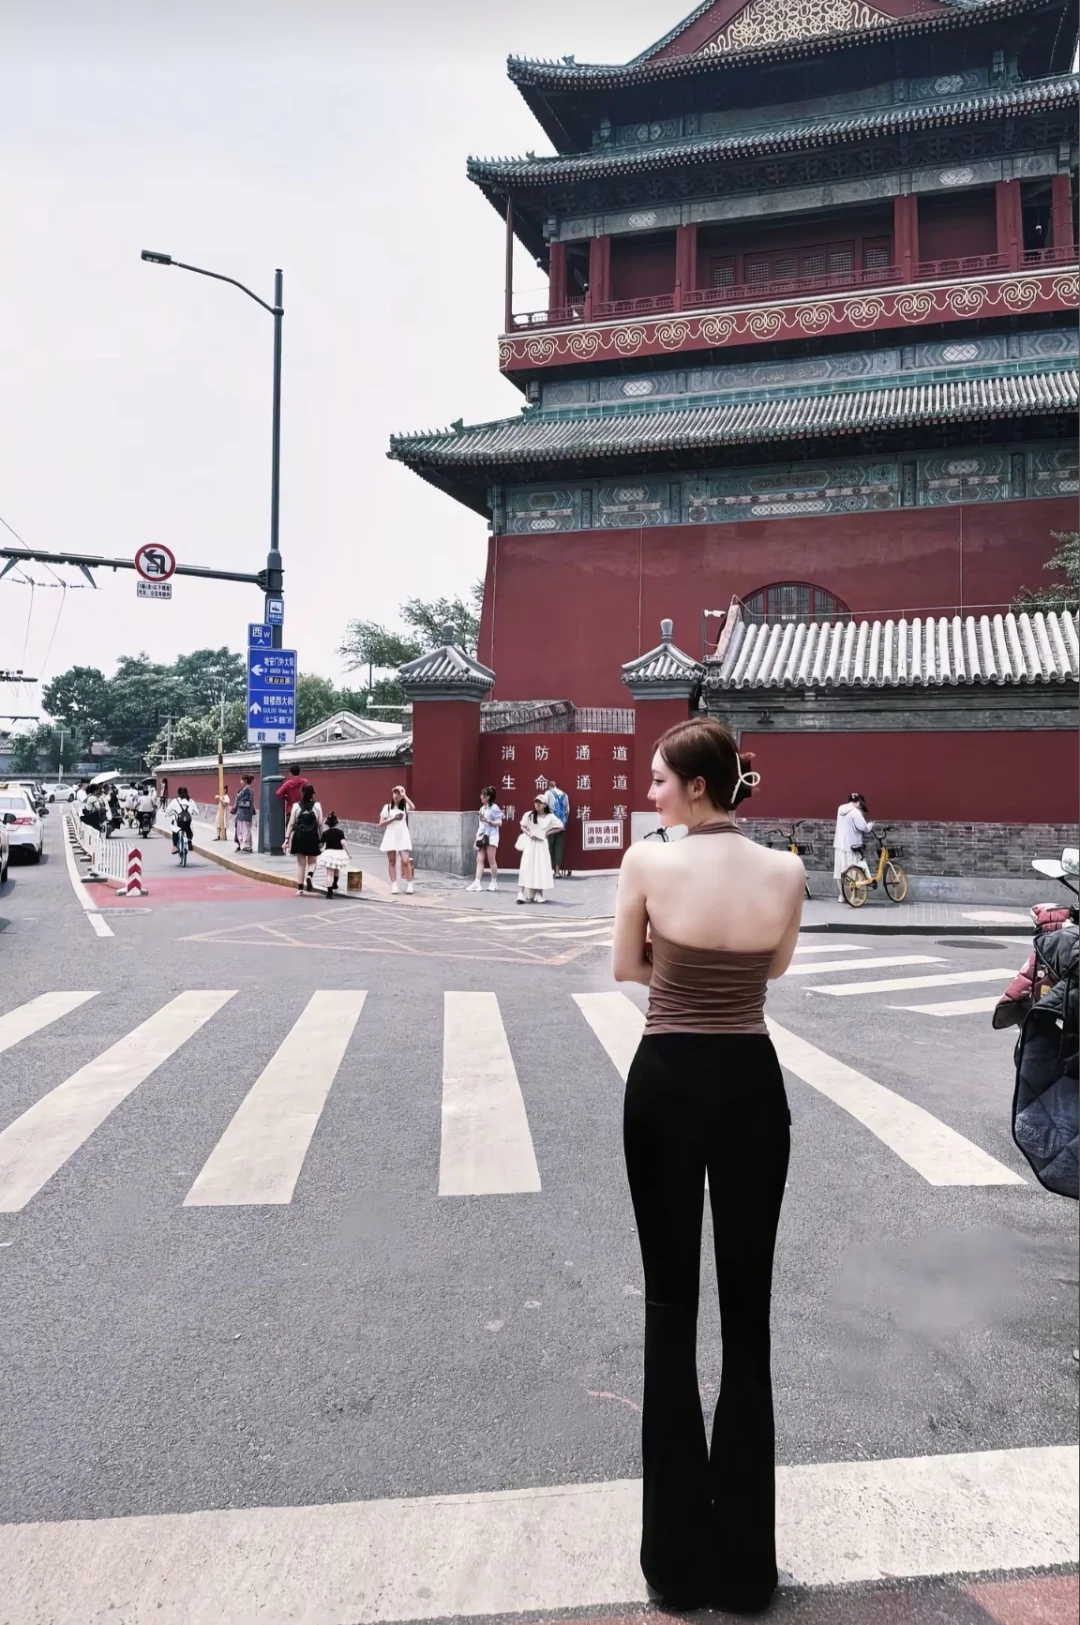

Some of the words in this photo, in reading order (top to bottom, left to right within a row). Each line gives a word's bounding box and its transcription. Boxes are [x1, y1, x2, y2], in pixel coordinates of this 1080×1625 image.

[252, 626, 263, 638] 西
[501, 745, 628, 761] 消防通道
[501, 774, 628, 790] 生命通道
[587, 825, 619, 835] 消防通道
[587, 835, 619, 844] 请勿占用
